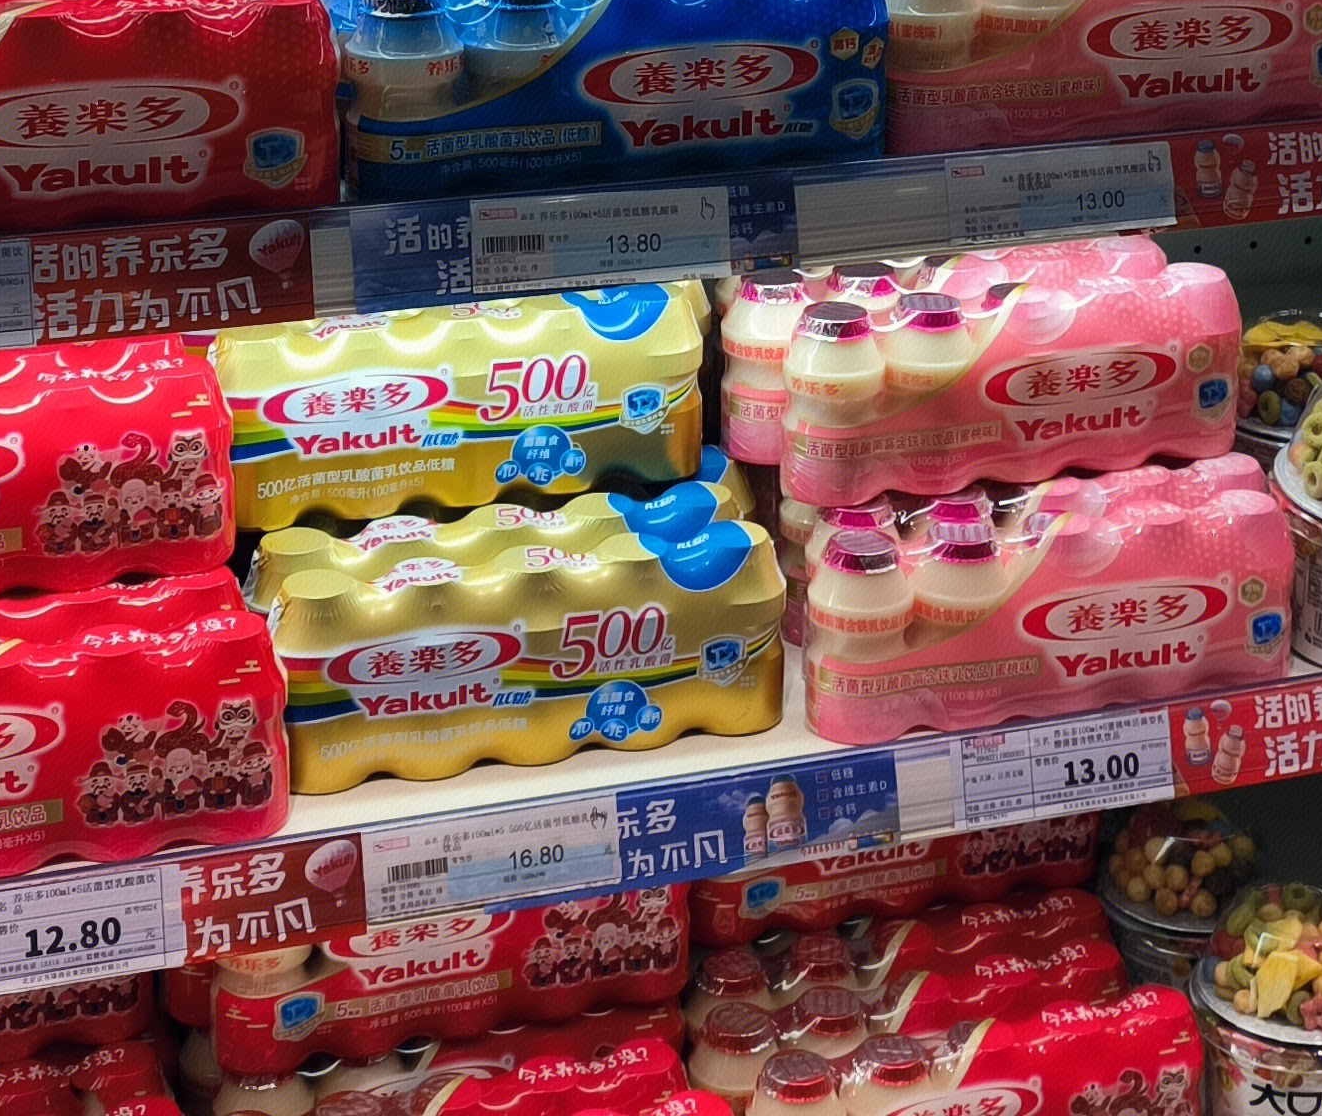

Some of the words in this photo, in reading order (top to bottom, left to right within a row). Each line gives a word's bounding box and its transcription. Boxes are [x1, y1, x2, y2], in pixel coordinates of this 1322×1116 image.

[1118, 67, 1262, 100] Yakult
[621, 112, 782, 148] Yakult
[3, 153, 200, 196] Yakult
[1075, 190, 1126, 212] 13.00
[33, 228, 229, 283] 活的养乐多
[605, 233, 661, 255] 13.80
[34, 276, 262, 340] 活力为不凡
[479, 354, 587, 423] 500
[521, 396, 594, 418] 活性乳酸菌
[1015, 406, 1147, 443] Yakult
[294, 425, 422, 456] Yakult
[552, 607, 665, 680] 500
[598, 649, 673, 673] 活性乳酸菌
[1056, 640, 1197, 679] Yakult
[358, 682, 493, 718] Yakult
[832, 768, 855, 781] 低糖
[1064, 752, 1139, 787] 13.00
[833, 780, 887, 800] 含维生素D
[833, 805, 858, 818] 含钙
[509, 844, 564, 869] 16.80
[627, 829, 728, 879] 为不凡
[25, 916, 121, 958] 12.80
[192, 897, 316, 957] 为不凡
[359, 948, 486, 986] Yakult
[369, 975, 499, 1014] 活菌型乳酸菌乳饮品
